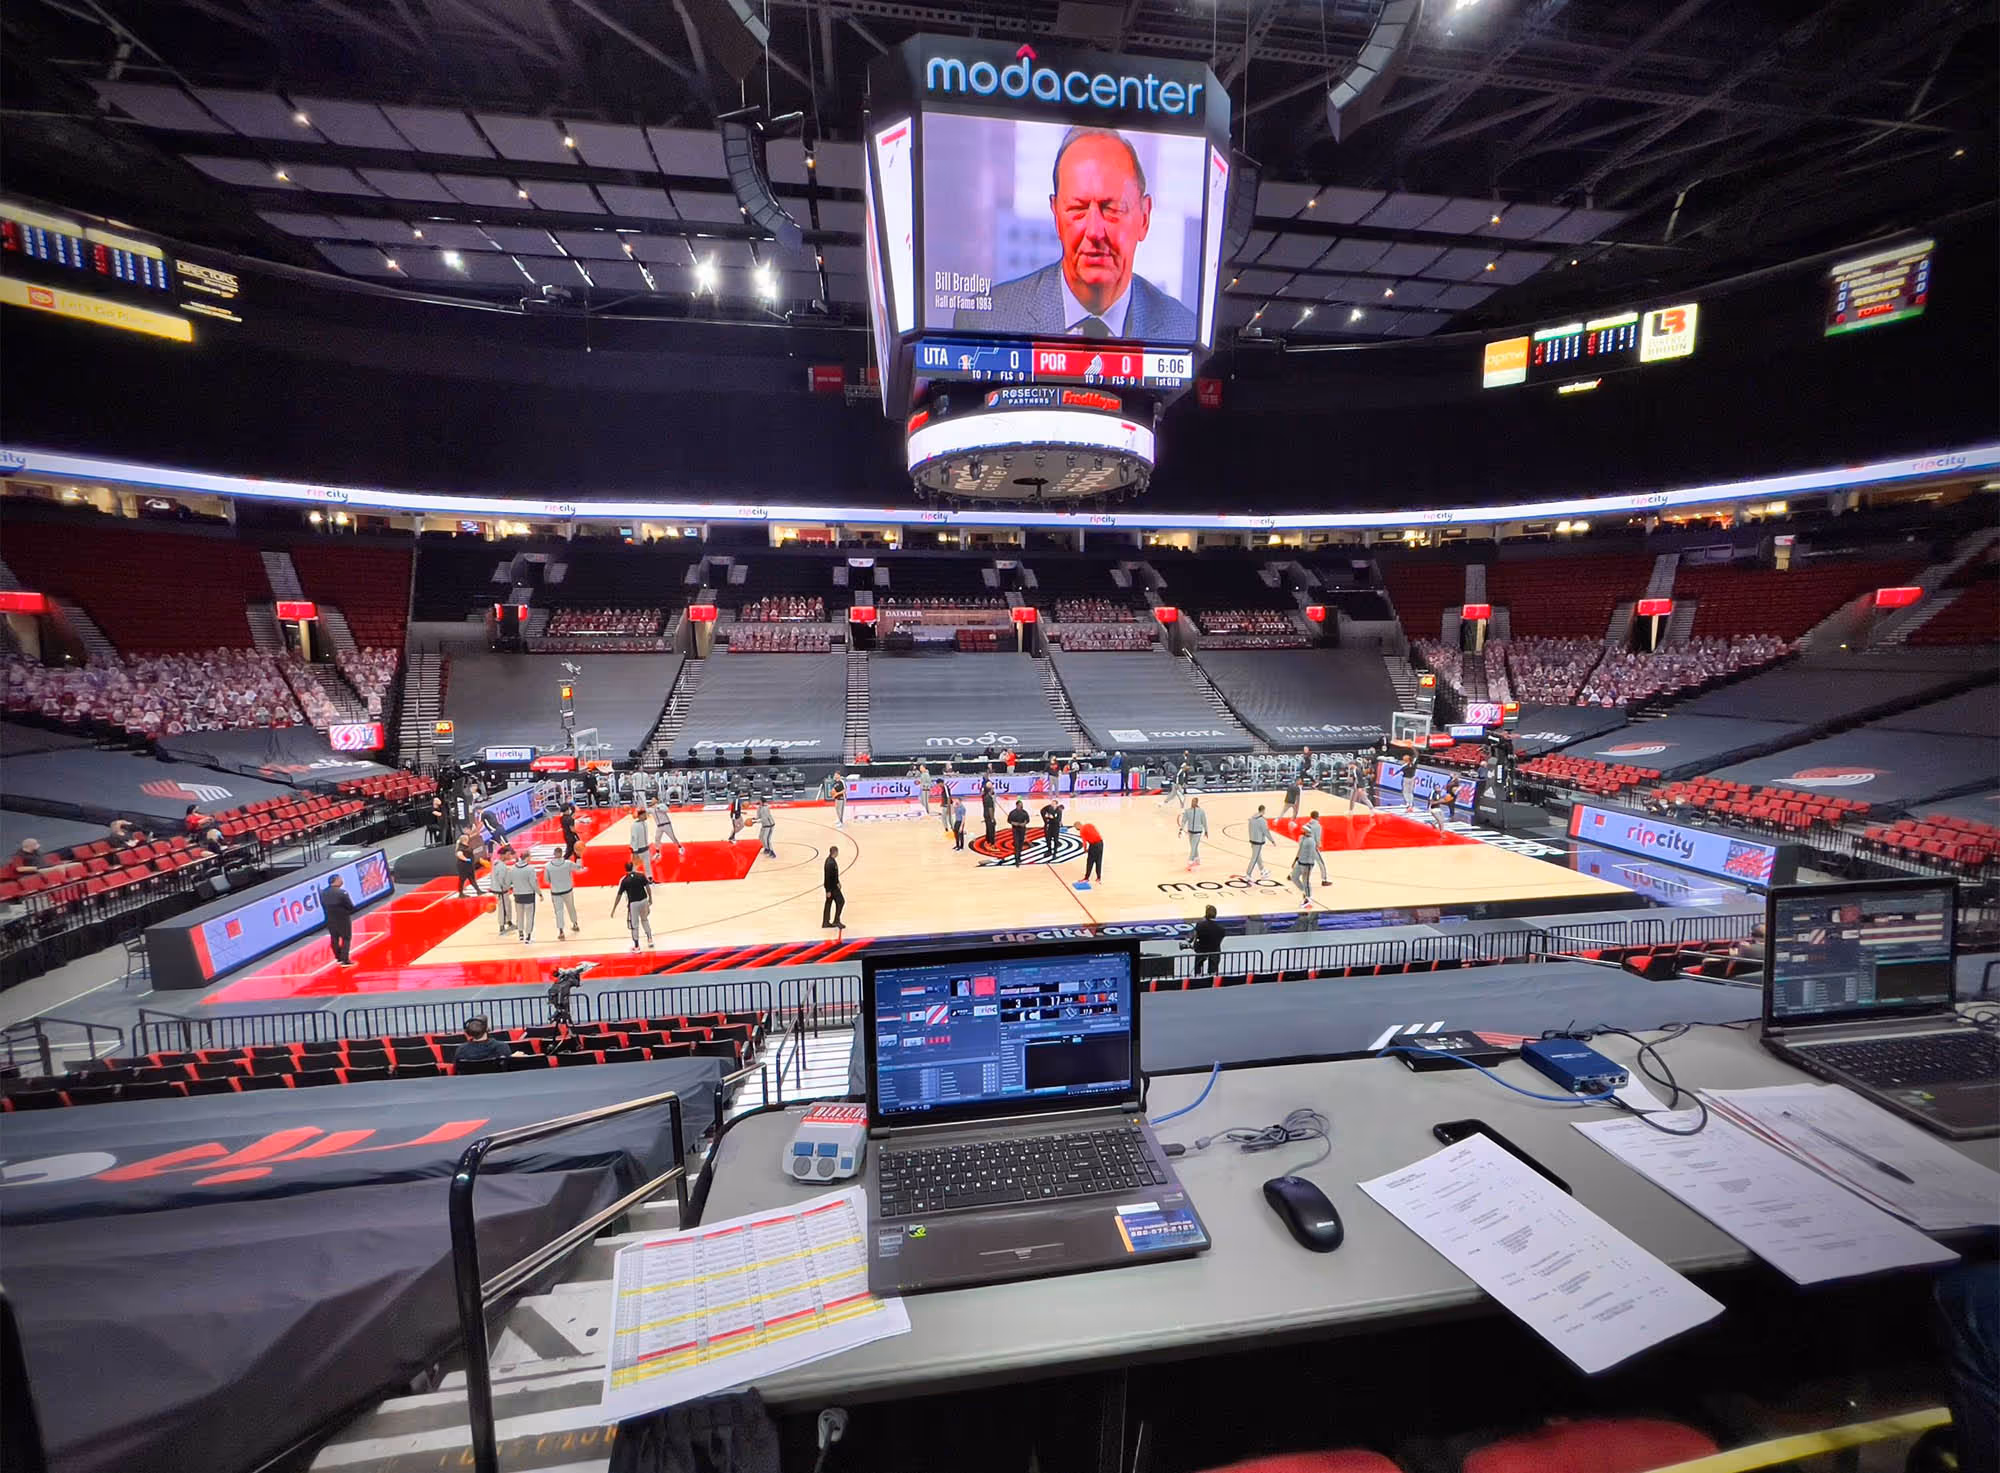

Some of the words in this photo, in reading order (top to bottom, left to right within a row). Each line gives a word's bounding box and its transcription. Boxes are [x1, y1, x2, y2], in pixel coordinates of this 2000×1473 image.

[935, 272, 951, 291] Bill
[953, 273, 992, 296] Bradley
[935, 294, 949, 308] Hall
[949, 296, 956, 308] of
[957, 296, 975, 310] Fame
[976, 297, 992, 311] 1983
[923, 347, 949, 366] UTA
[1010, 351, 1019, 369] 0
[1040, 353, 1066, 371] POR
[1122, 356, 1131, 374] 0
[1157, 358, 1184, 374] 6:06
[972, 370, 981, 379] TO
[986, 371, 991, 380] 7
[1000, 371, 1014, 380] FLS
[1019, 372, 1024, 381] 0
[1085, 375, 1094, 384] TO
[1098, 376, 1104, 384] 7
[1112, 376, 1125, 385] FLS
[1130, 376, 1135, 385] 0
[1911, 454, 1967, 472] ripcity
[306, 488, 349, 504] ripcity
[1630, 492, 1669, 505] ripcity
[544, 503, 576, 517] ripcity
[738, 507, 768, 519] ripcity
[920, 511, 948, 523] ripcity
[1089, 515, 1116, 526] ripcity
[885, 610, 923, 618] DAIMLER
[1150, 729, 1225, 738] TOYOTA
[1275, 725, 1320, 733] First
[1341, 724, 1384, 732] Tech
[926, 733, 1018, 747] moda
[495, 751, 524, 759] ripcity
[871, 780, 911, 797] ripcity
[1076, 776, 1109, 792] ipcity
[495, 801, 520, 825] ipcity
[1626, 821, 1695, 860] ripcity
[992, 922, 1197, 943] ripcity.orego
